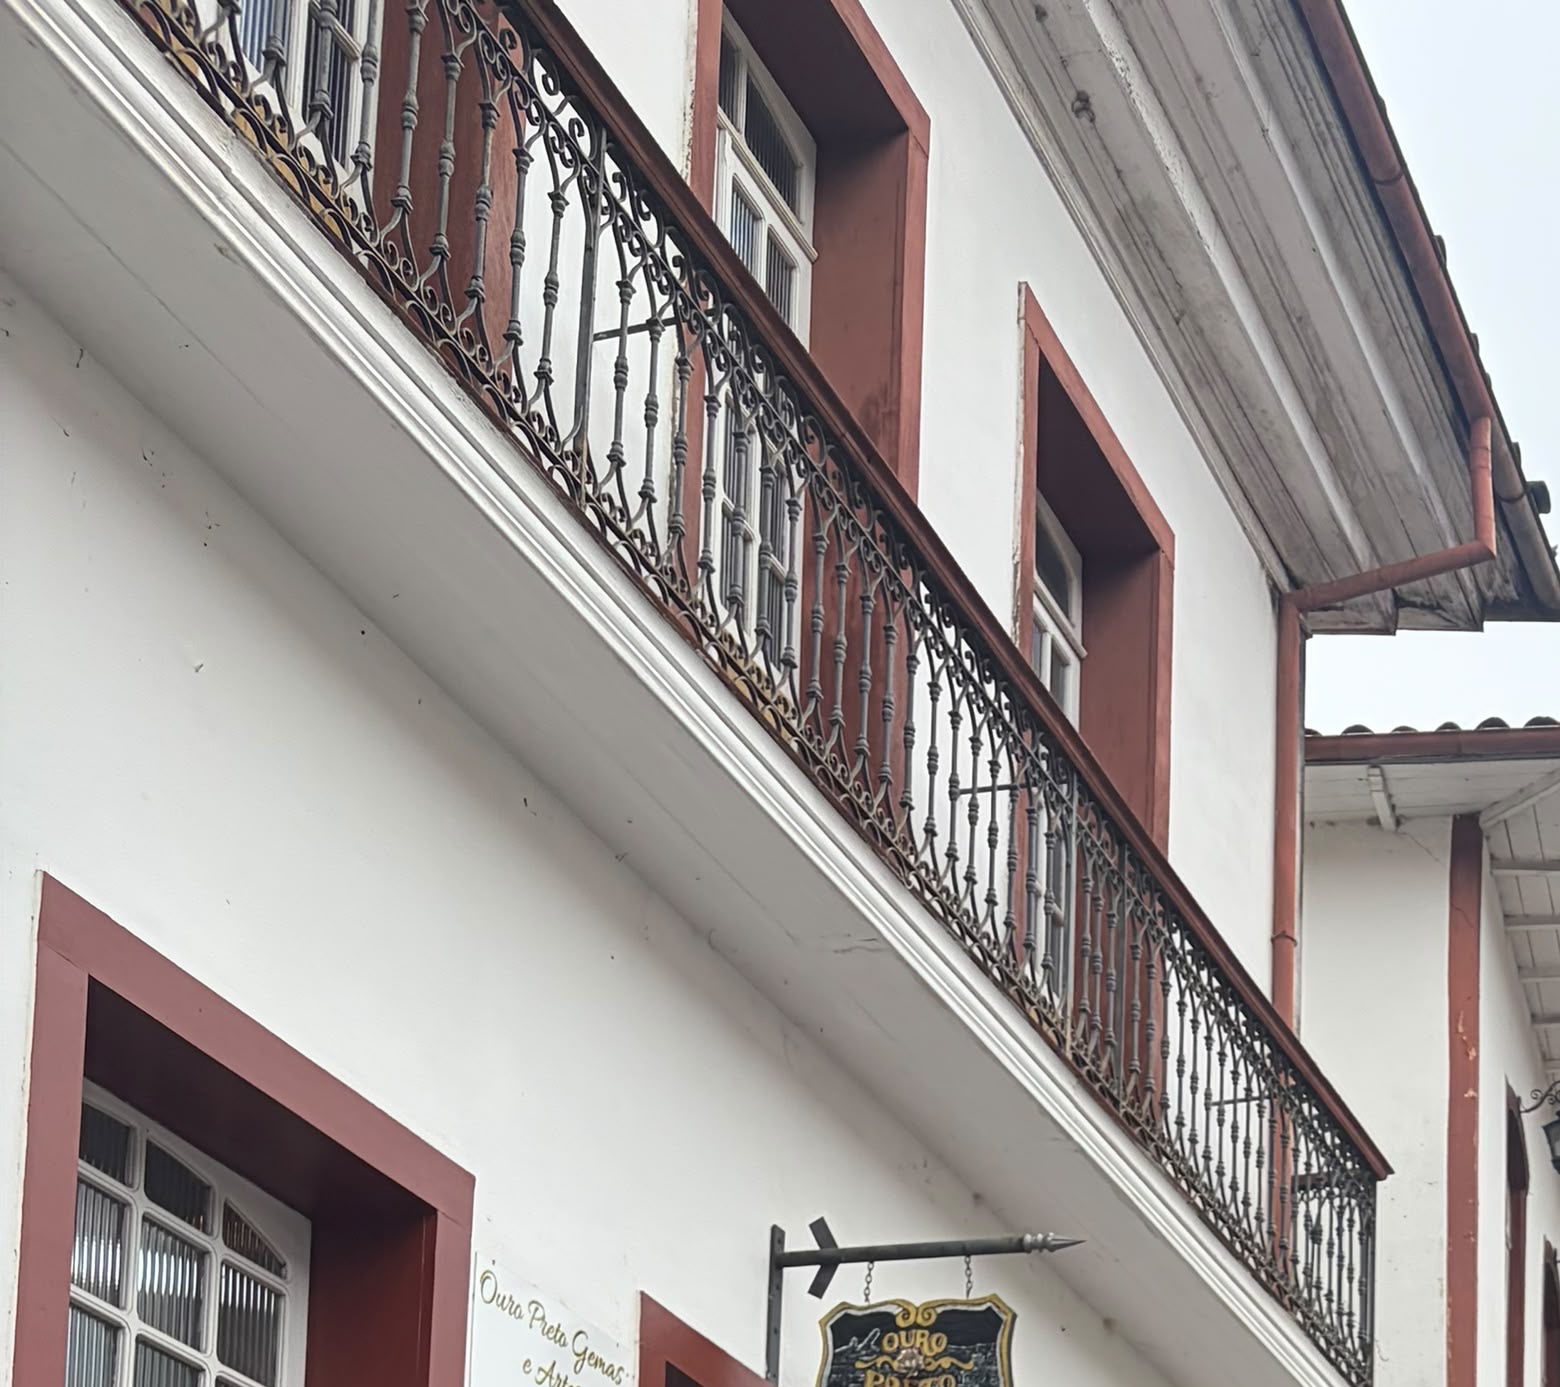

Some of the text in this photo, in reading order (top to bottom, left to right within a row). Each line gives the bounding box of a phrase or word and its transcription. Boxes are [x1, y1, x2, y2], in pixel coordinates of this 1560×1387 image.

[480, 1269, 624, 1386] Ouro Preto Gemas
[882, 1329, 948, 1356] OURO
[522, 1358, 532, 1374] e
